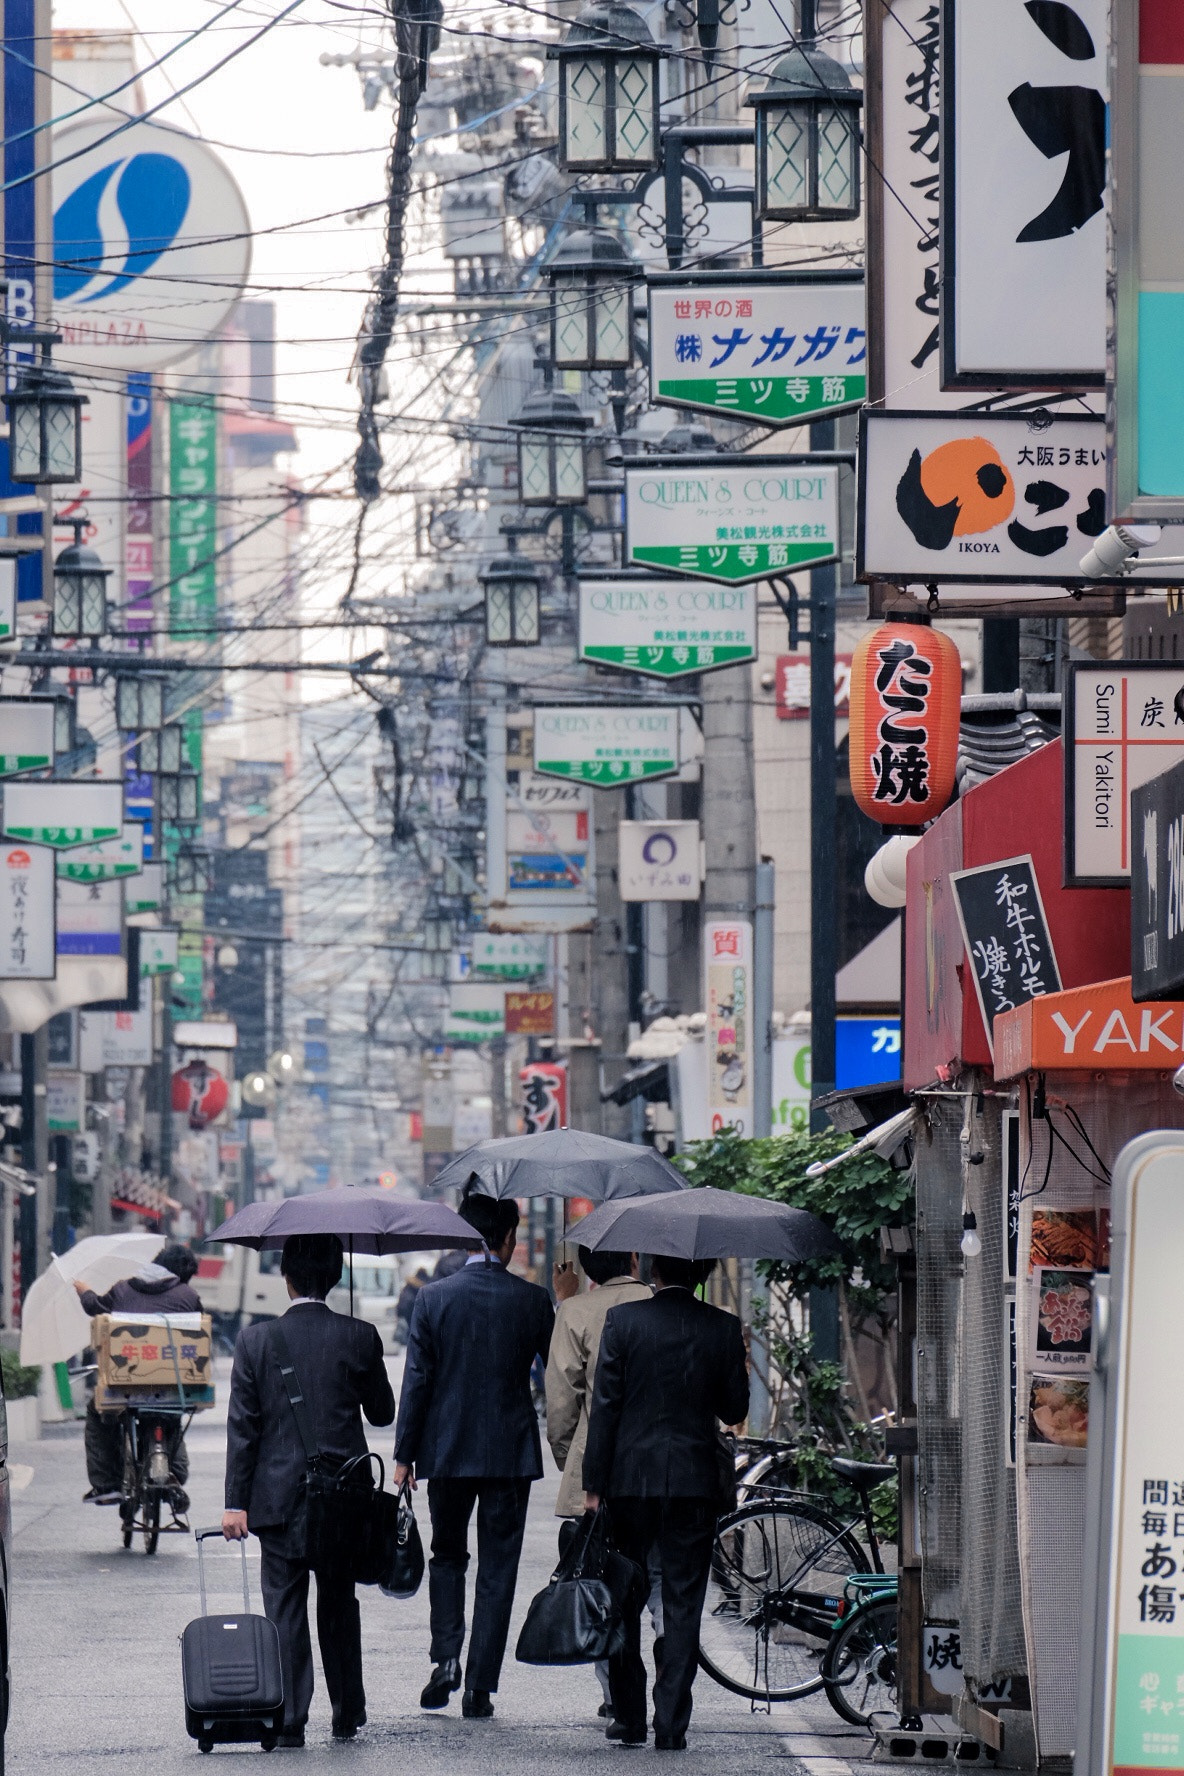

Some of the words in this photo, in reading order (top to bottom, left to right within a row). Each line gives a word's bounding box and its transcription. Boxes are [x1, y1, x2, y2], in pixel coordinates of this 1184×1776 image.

[674, 299, 753, 319] 世界の酒
[714, 376, 846, 405] 三ツ寺筋
[639, 478, 733, 511] QUEEN'S
[743, 478, 828, 502] COURT
[716, 523, 827, 541] 美松観光株式会社
[678, 543, 789, 568] 三ツ寺筋
[958, 542, 1001, 553] IKOYA
[590, 589, 669, 617] QUEEN'S
[677, 590, 749, 612] COURT
[622, 645, 715, 665] 三ツ寺筋
[874, 640, 932, 804] たこ焼
[1095, 684, 1115, 734] Sumi
[1095, 751, 1114, 828] Yakitori
[713, 930, 739, 956] 質
[871, 1027, 901, 1053] カ
[1051, 1009, 1184, 1054] YAK
